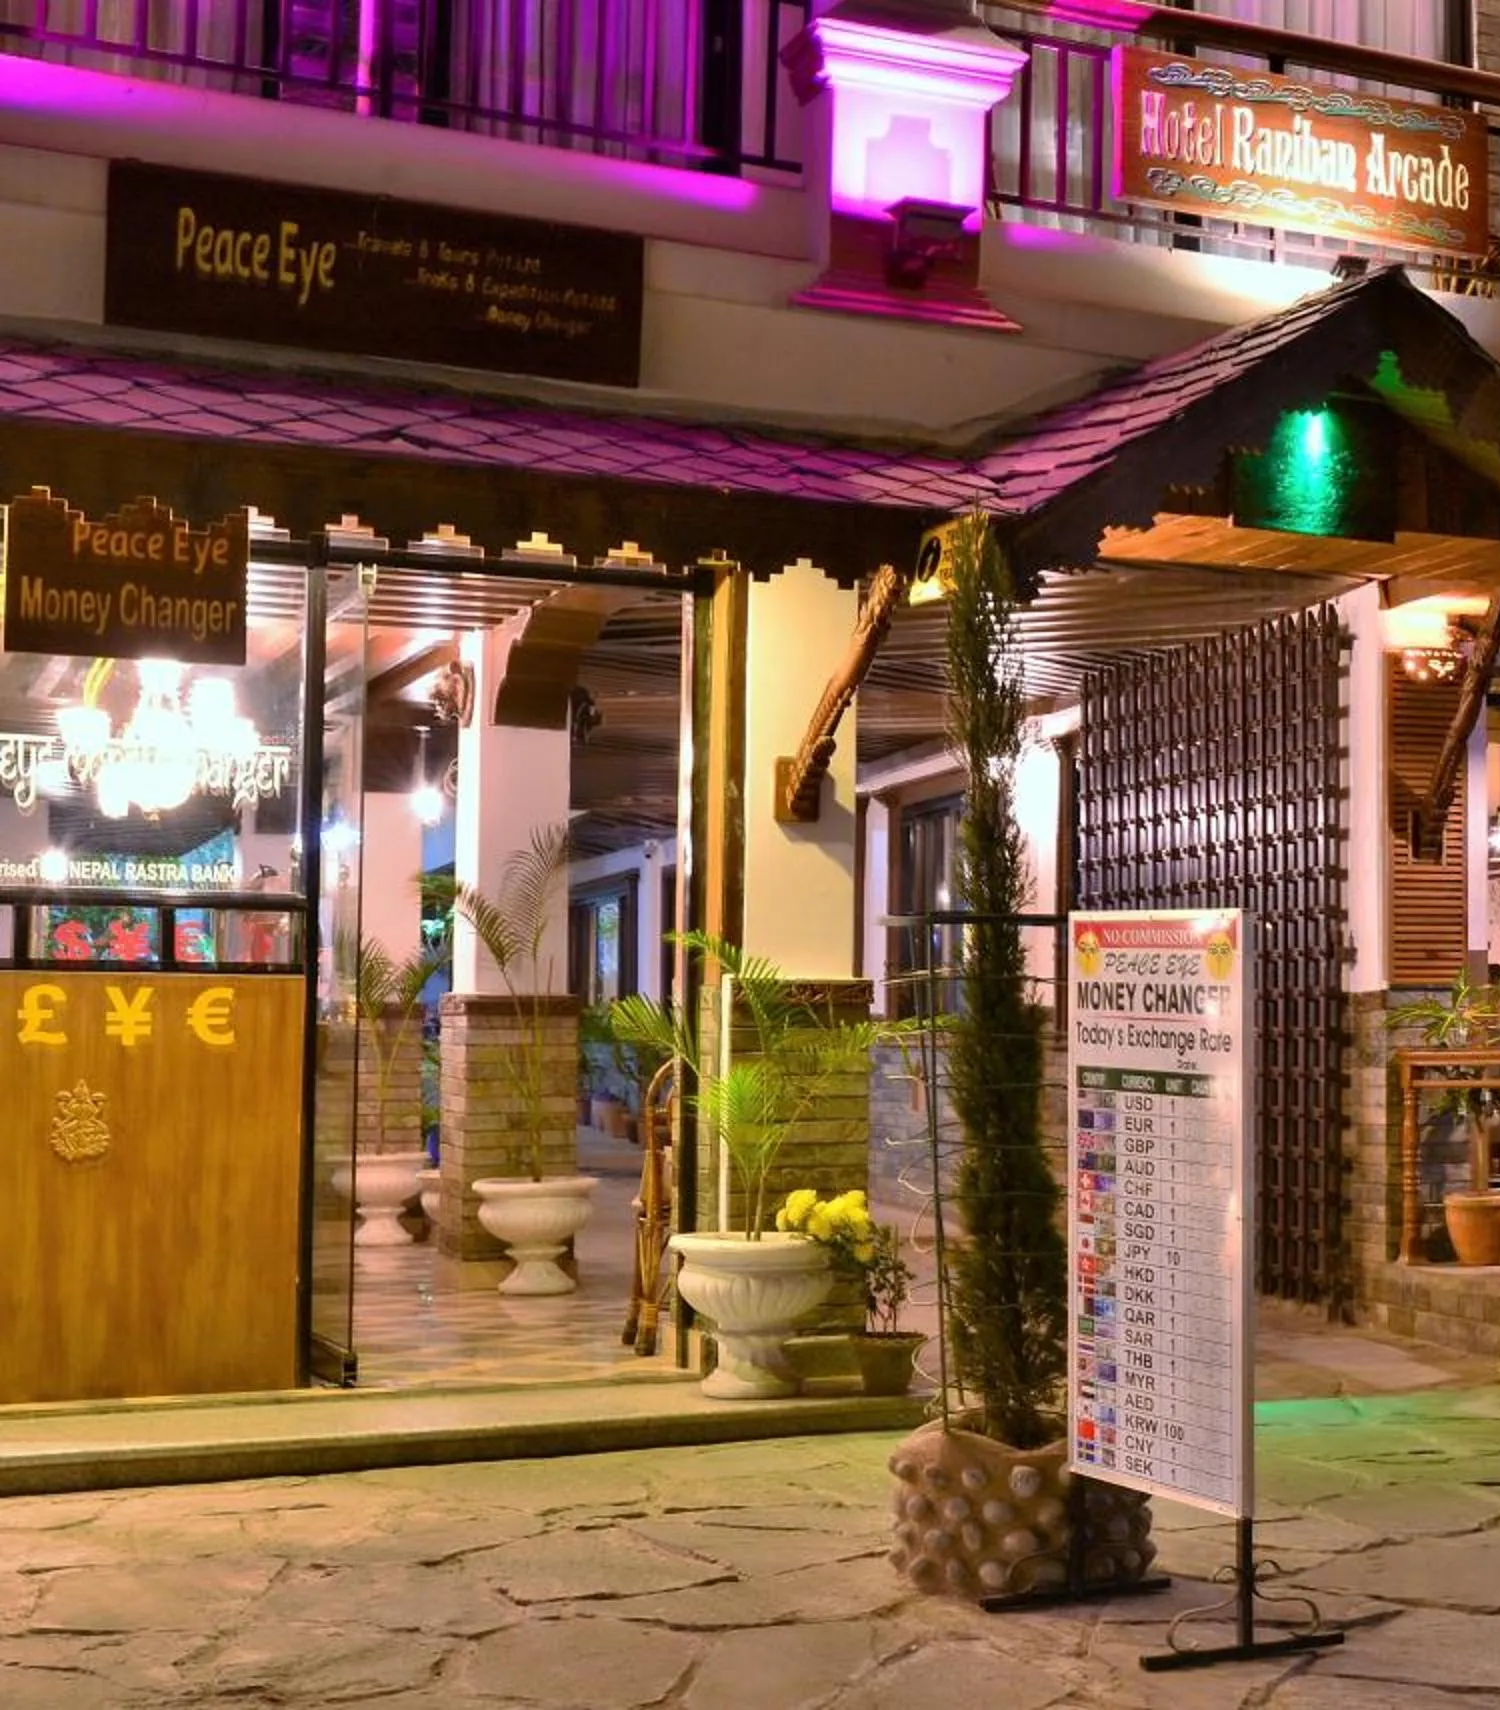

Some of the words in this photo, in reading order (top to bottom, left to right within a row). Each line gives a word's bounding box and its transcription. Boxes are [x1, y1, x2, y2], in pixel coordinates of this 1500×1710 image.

[1140, 89, 1226, 166] Hotel
[1365, 131, 1469, 212] Arcade
[176, 207, 270, 279] Peace
[279, 221, 336, 305] Eye
[72, 519, 165, 562] Peace
[173, 525, 230, 575] Eye
[20, 575, 112, 635] Money
[119, 581, 238, 641] Changer
[69, 860, 122, 881] NEPAL
[125, 861, 188, 882] RASTRA
[1077, 981, 1137, 1012] MONEY
[1077, 1021, 1123, 1050] Today's
[1128, 1024, 1195, 1056] Exchange
[1125, 1096, 1153, 1112] USD
[1125, 1117, 1154, 1134] EUR
[1124, 1138, 1155, 1153] GBP
[1124, 1160, 1155, 1176] AUD
[1124, 1180, 1153, 1197] CHF
[1124, 1202, 1155, 1219] CAD
[1124, 1224, 1155, 1240] SGD
[1124, 1245, 1151, 1260] JPY
[1167, 1251, 1181, 1266] 10
[1124, 1266, 1154, 1284] HKD
[1124, 1286, 1154, 1304] DKK
[1124, 1307, 1155, 1326] QAR
[1124, 1328, 1153, 1347] SAR
[1125, 1349, 1153, 1368] THB
[1125, 1371, 1155, 1391] MYR
[1124, 1392, 1154, 1412] AED
[1125, 1414, 1158, 1433] KRW
[1163, 1422, 1185, 1441] 100
[1125, 1435, 1153, 1455] CNY
[1125, 1454, 1154, 1476] SEK
